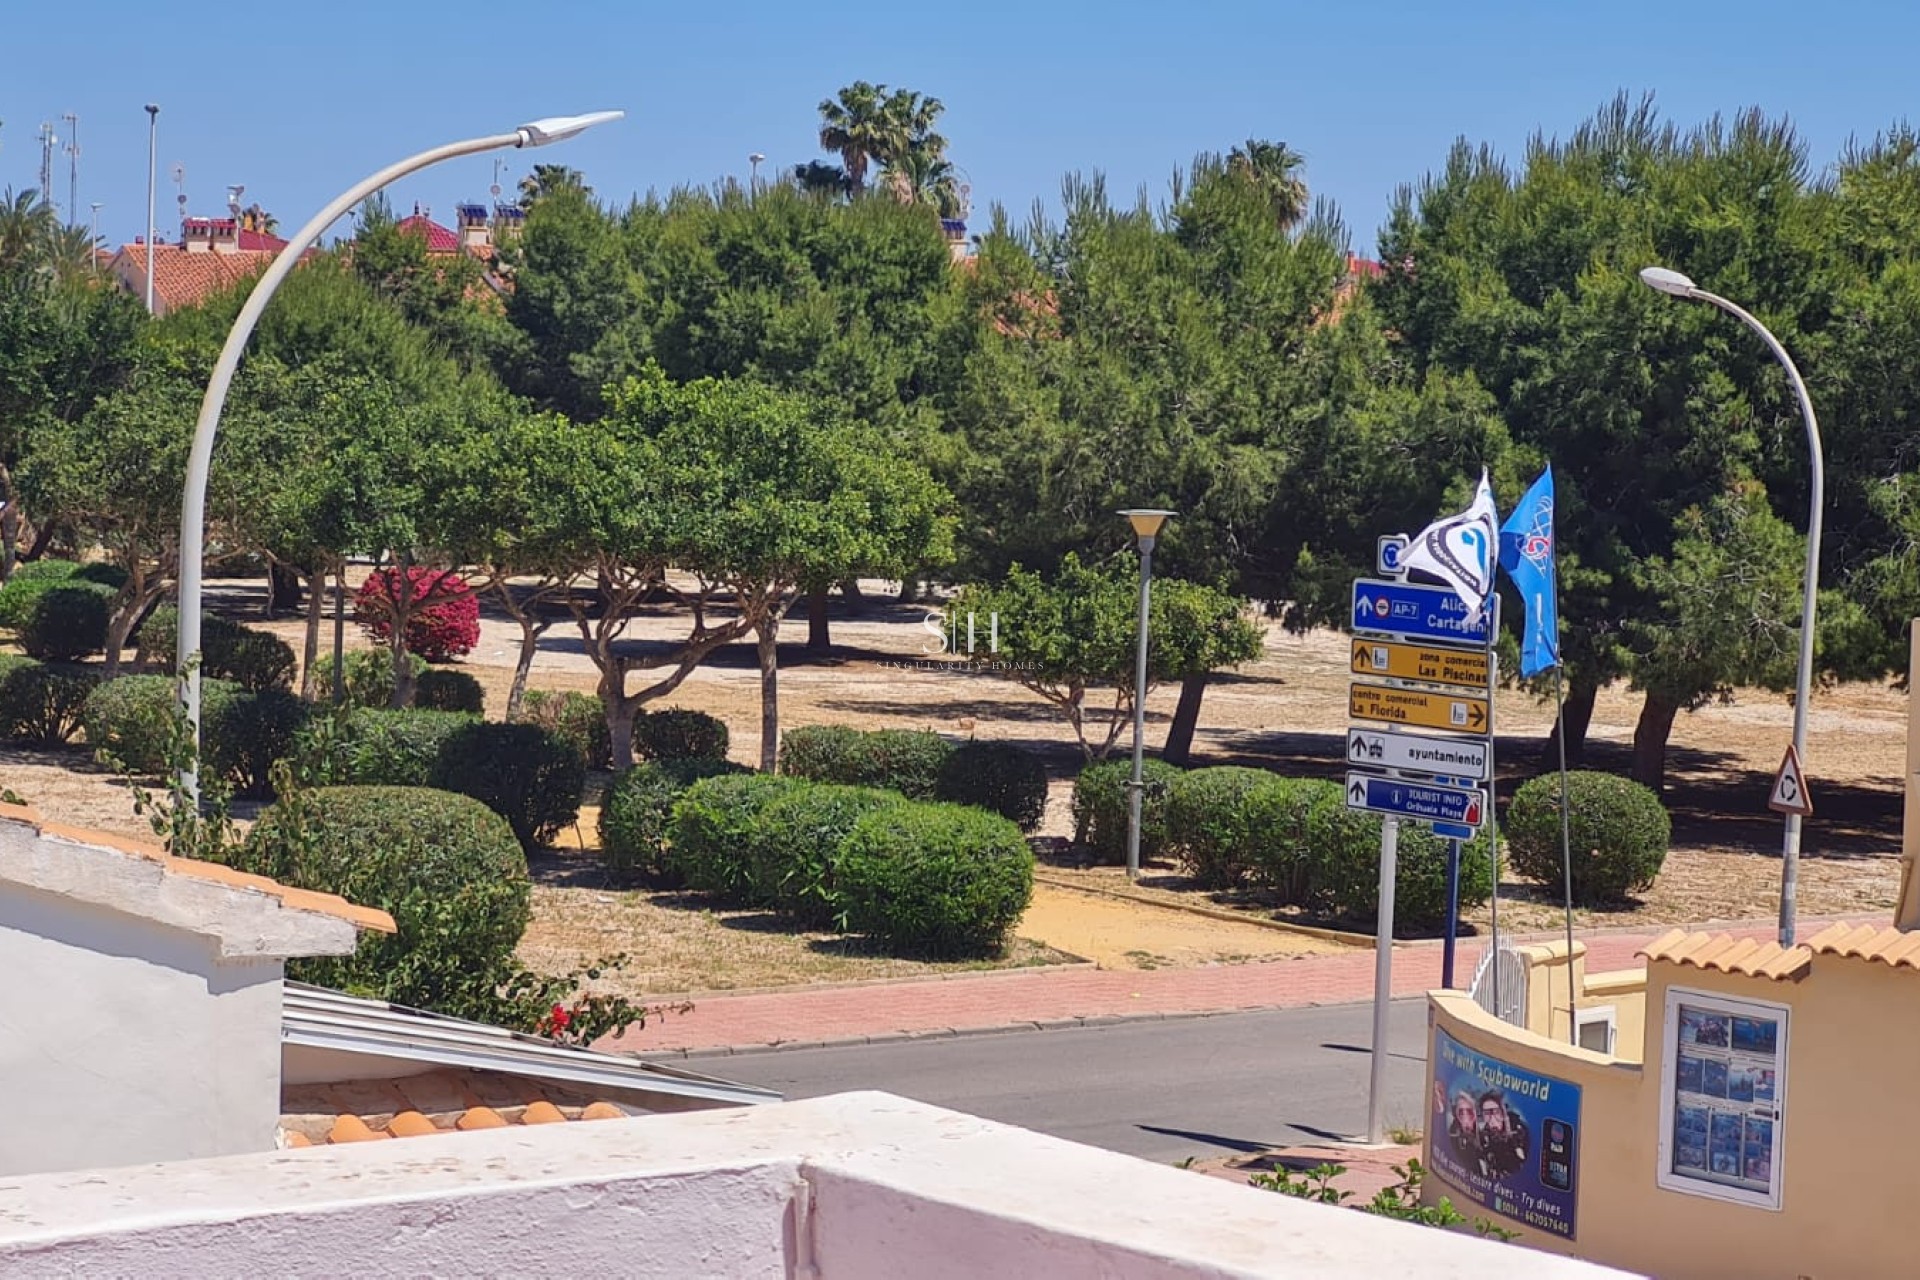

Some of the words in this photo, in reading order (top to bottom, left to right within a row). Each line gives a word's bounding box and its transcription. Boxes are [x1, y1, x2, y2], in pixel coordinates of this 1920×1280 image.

[1394, 603, 1417, 616] AP-7
[1418, 663, 1436, 677] Las
[1443, 667, 1487, 683] Piscinas
[1353, 700, 1364, 713] La
[1370, 703, 1406, 718] Florida
[1385, 695, 1428, 707] comercial
[1408, 748, 1483, 766] ayuntamiento
[1408, 789, 1441, 803] TOURIST
[1443, 794, 1463, 806] INFO
[1478, 1060, 1550, 1101] Scubaworld
[1522, 1192, 1535, 1209] Try
[1536, 1198, 1561, 1216] dives
